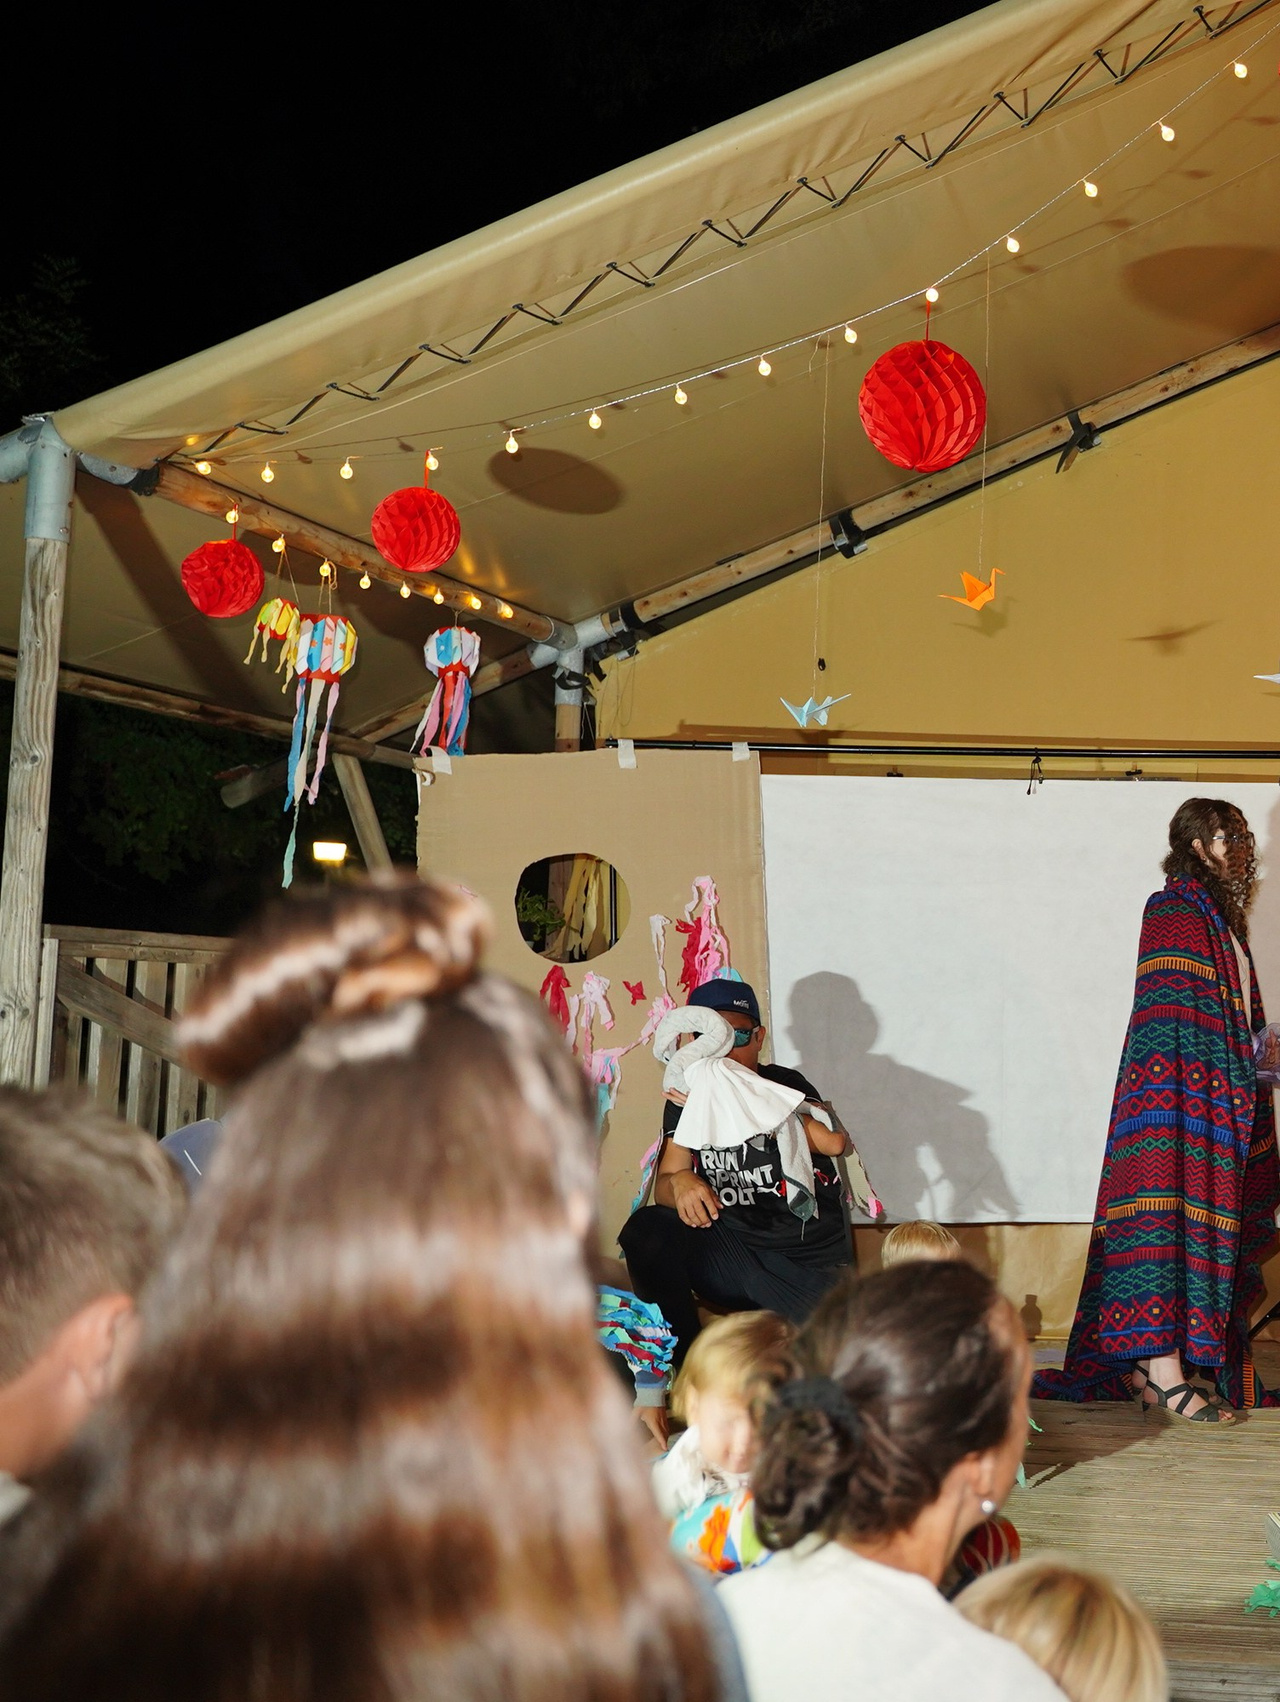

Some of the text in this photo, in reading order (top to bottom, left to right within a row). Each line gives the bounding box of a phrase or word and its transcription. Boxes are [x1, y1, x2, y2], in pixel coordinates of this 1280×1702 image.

[700, 1150, 740, 1171] RUN
[705, 1164, 773, 1189] SPRINT
[711, 1186, 756, 1207] OLT
